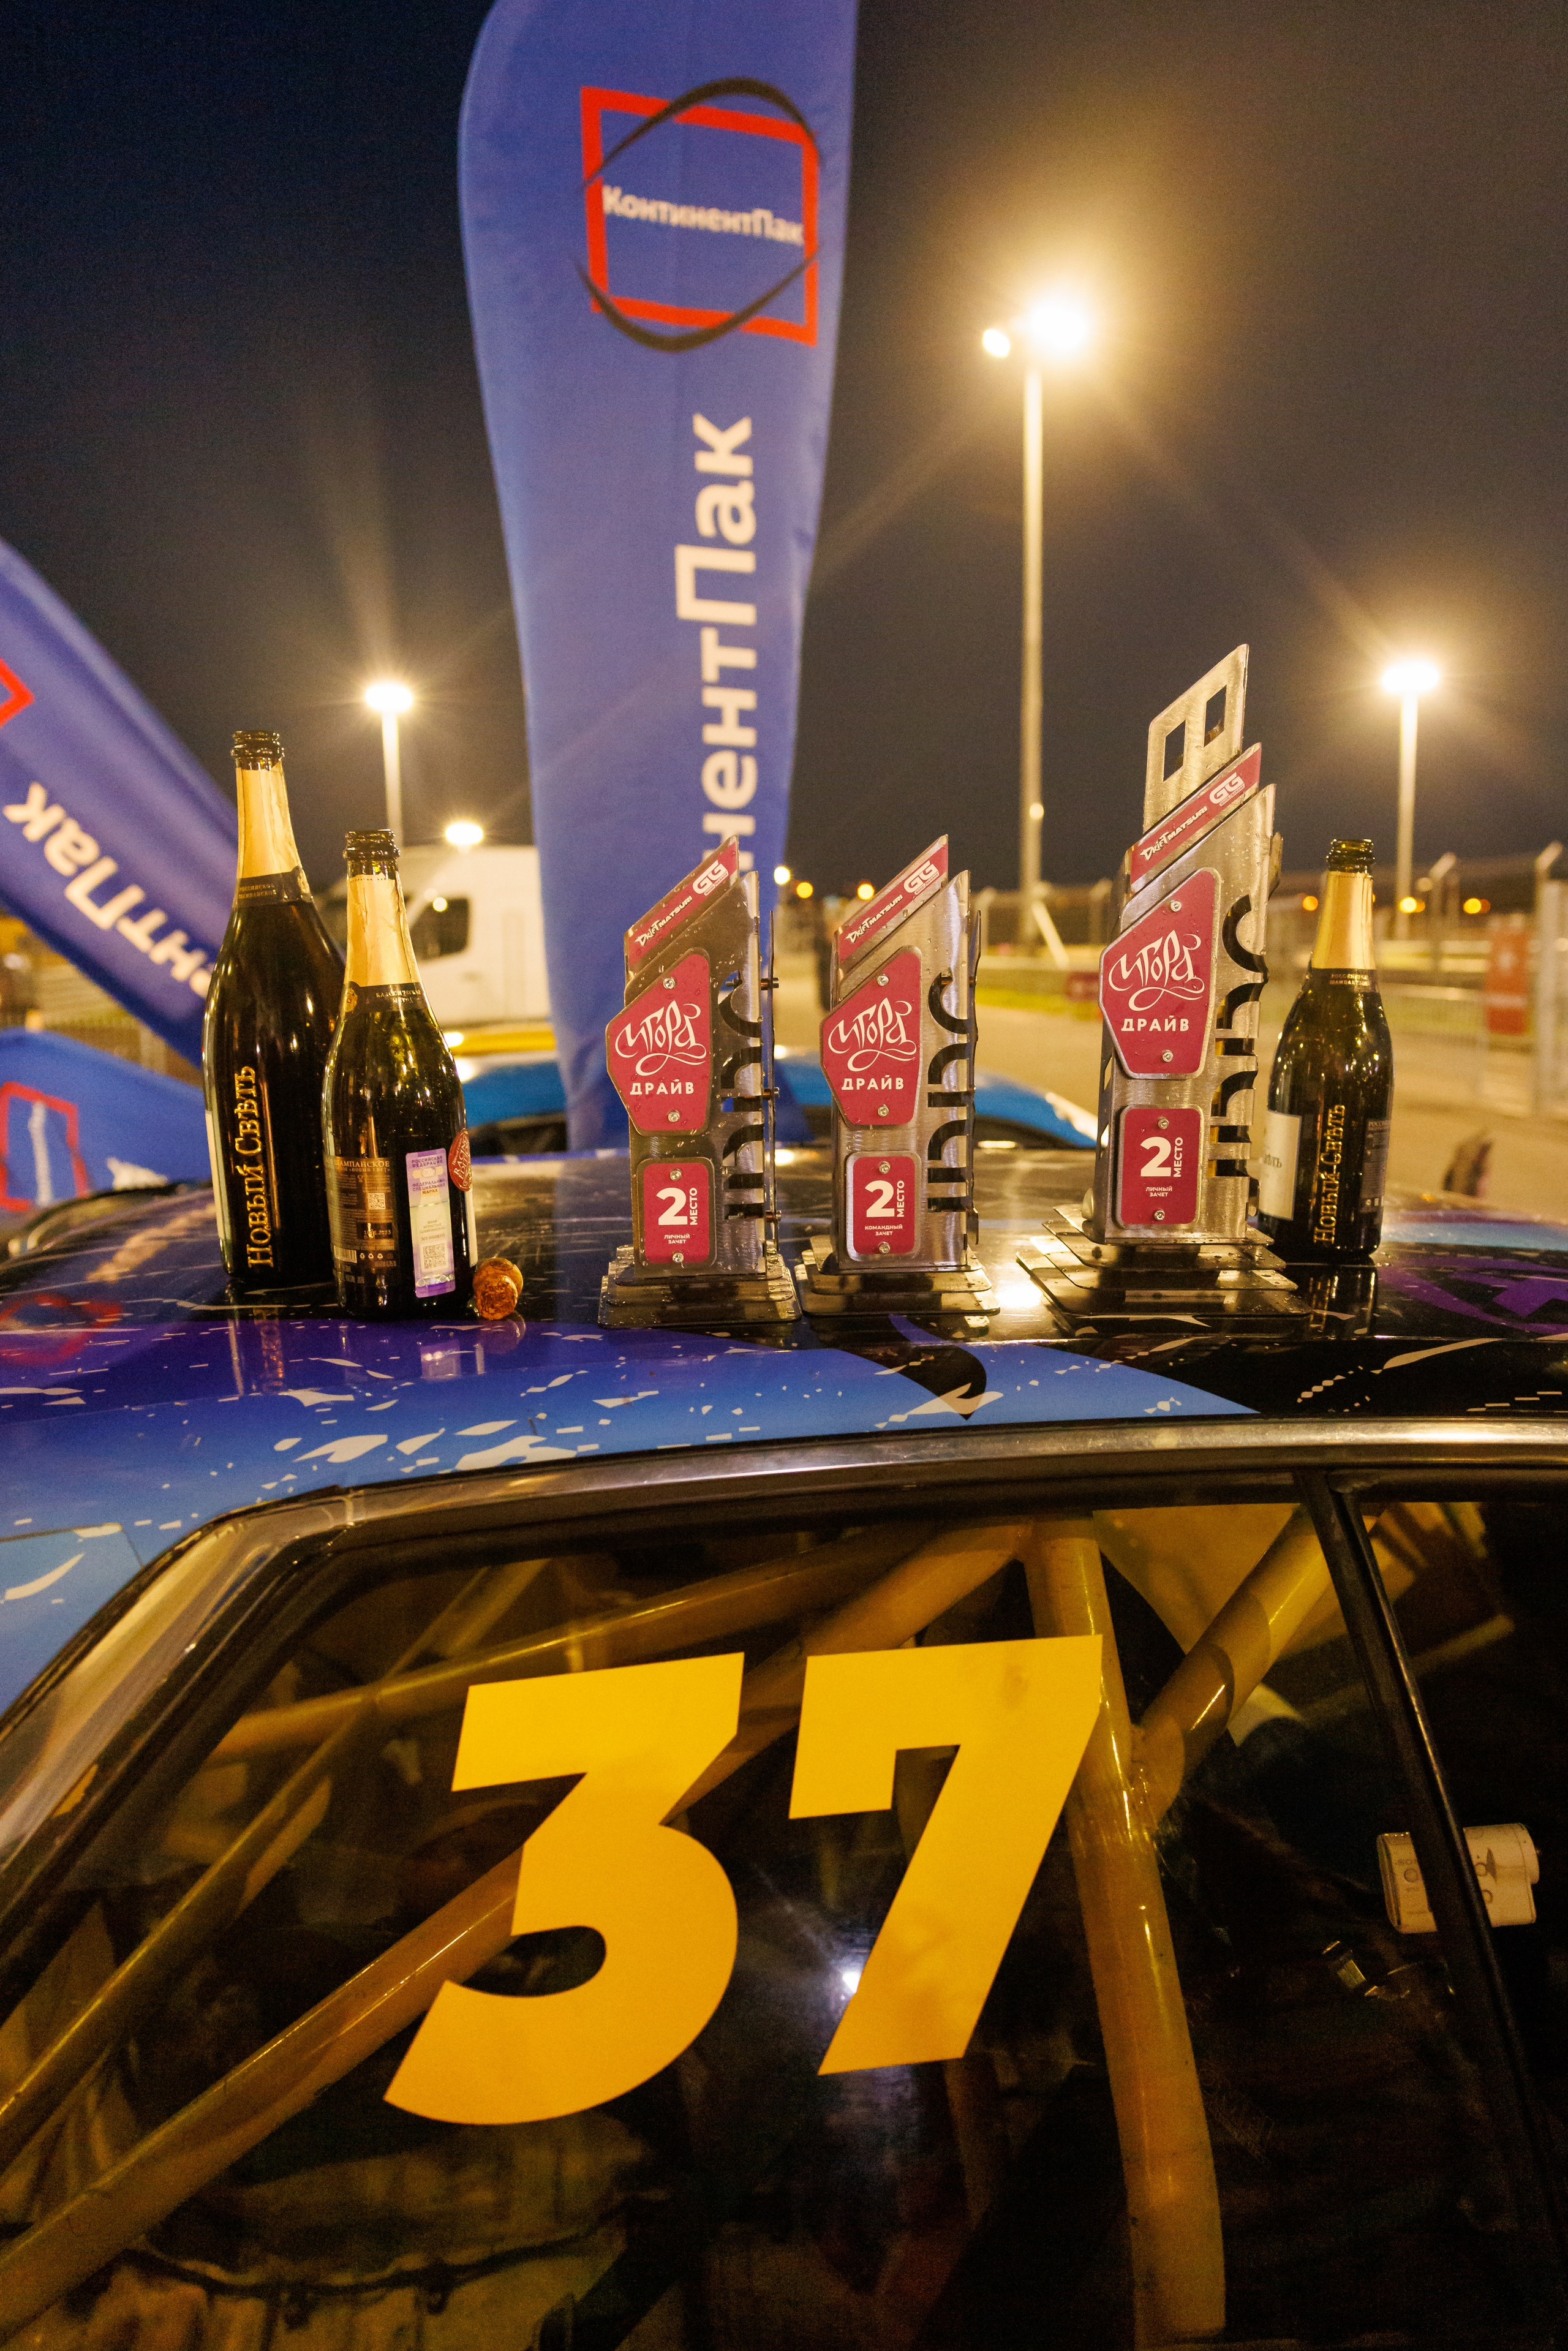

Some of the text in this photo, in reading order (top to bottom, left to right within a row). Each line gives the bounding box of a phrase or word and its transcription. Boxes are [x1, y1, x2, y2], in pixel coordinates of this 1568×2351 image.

[1121, 1015, 1189, 1032] ДРАЙВ
[630, 1079, 694, 1095] ДРАЙВ
[842, 1075, 904, 1090] ДРАЙВ
[1140, 1136, 1171, 1177] 2
[1174, 1137, 1183, 1177] МЕСТО
[656, 1187, 688, 1225] 2
[865, 1180, 895, 1217] 2
[383, 1634, 1102, 2125] 37
